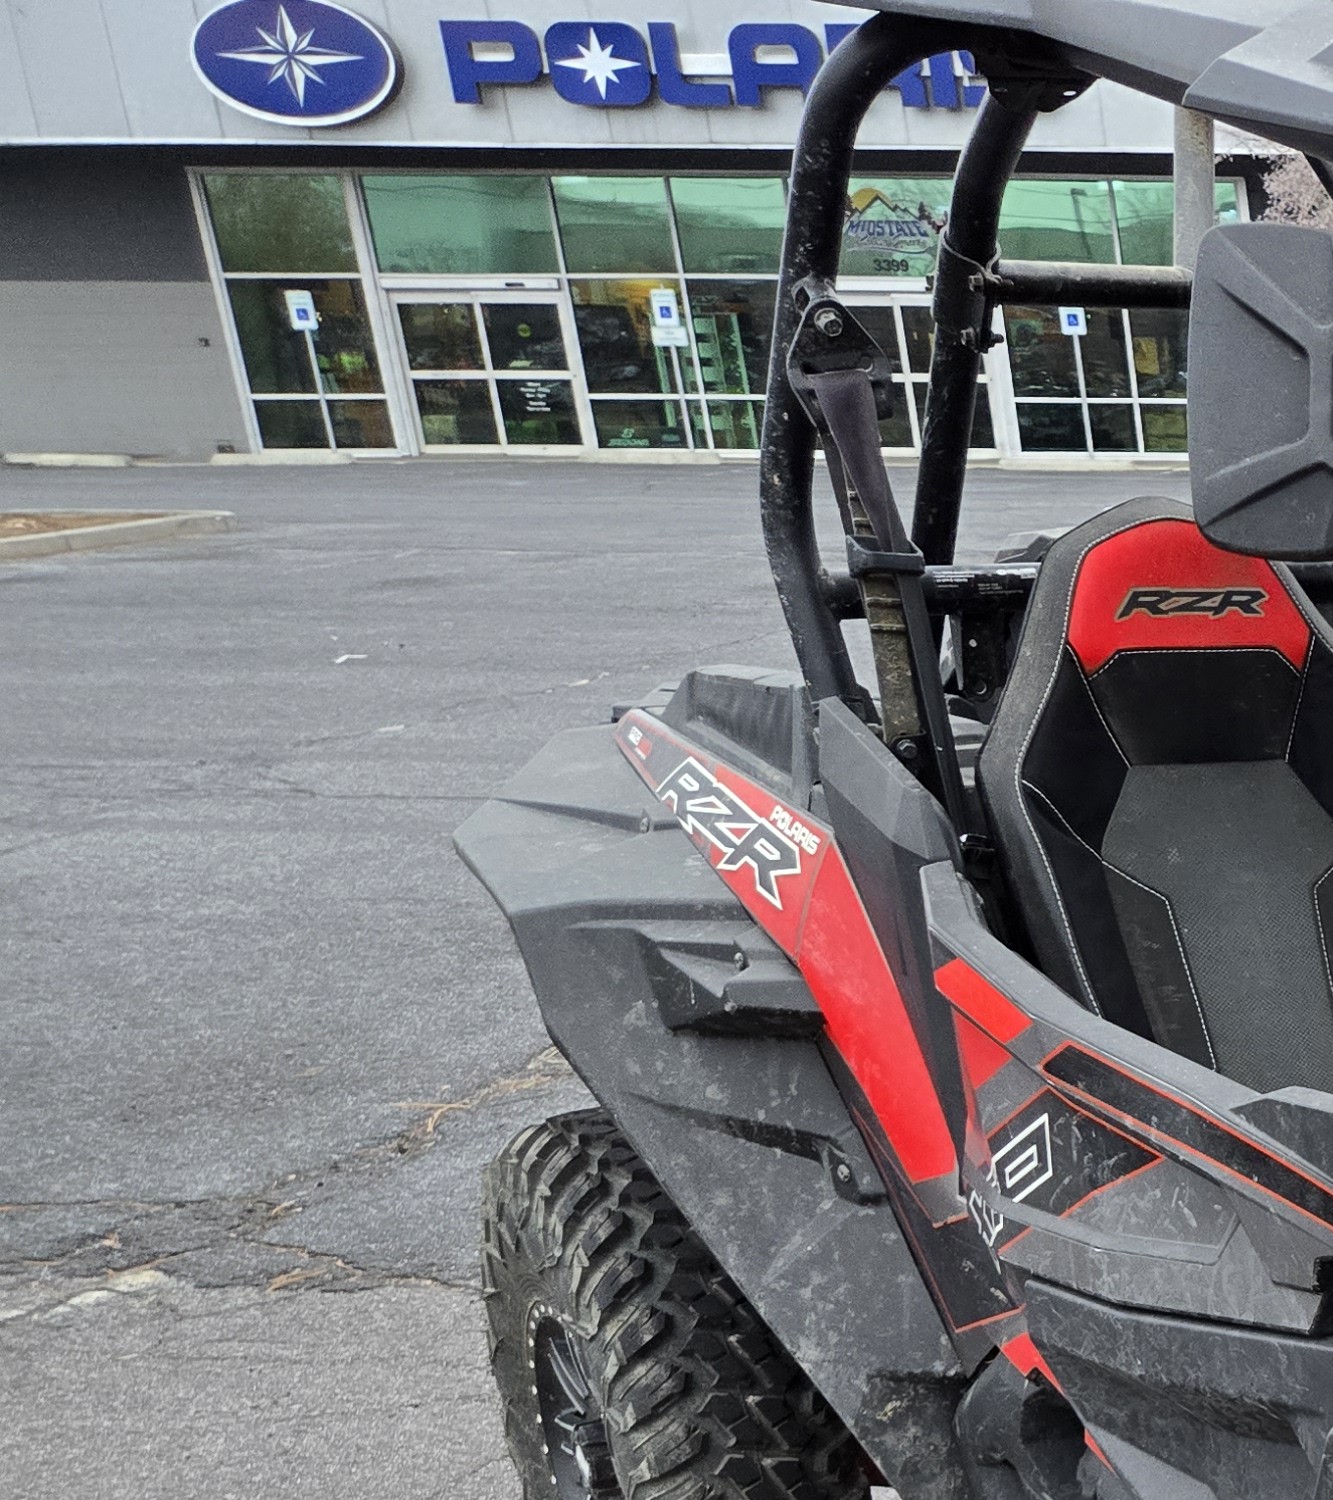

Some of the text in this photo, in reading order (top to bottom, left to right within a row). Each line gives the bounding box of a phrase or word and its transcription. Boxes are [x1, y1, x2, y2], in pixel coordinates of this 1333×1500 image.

[849, 220, 930, 238] MIDSTATE
[873, 257, 909, 272] 3399
[1115, 586, 1269, 622] RZR
[656, 756, 801, 911] RZR
[769, 805, 821, 855] POLARIS
